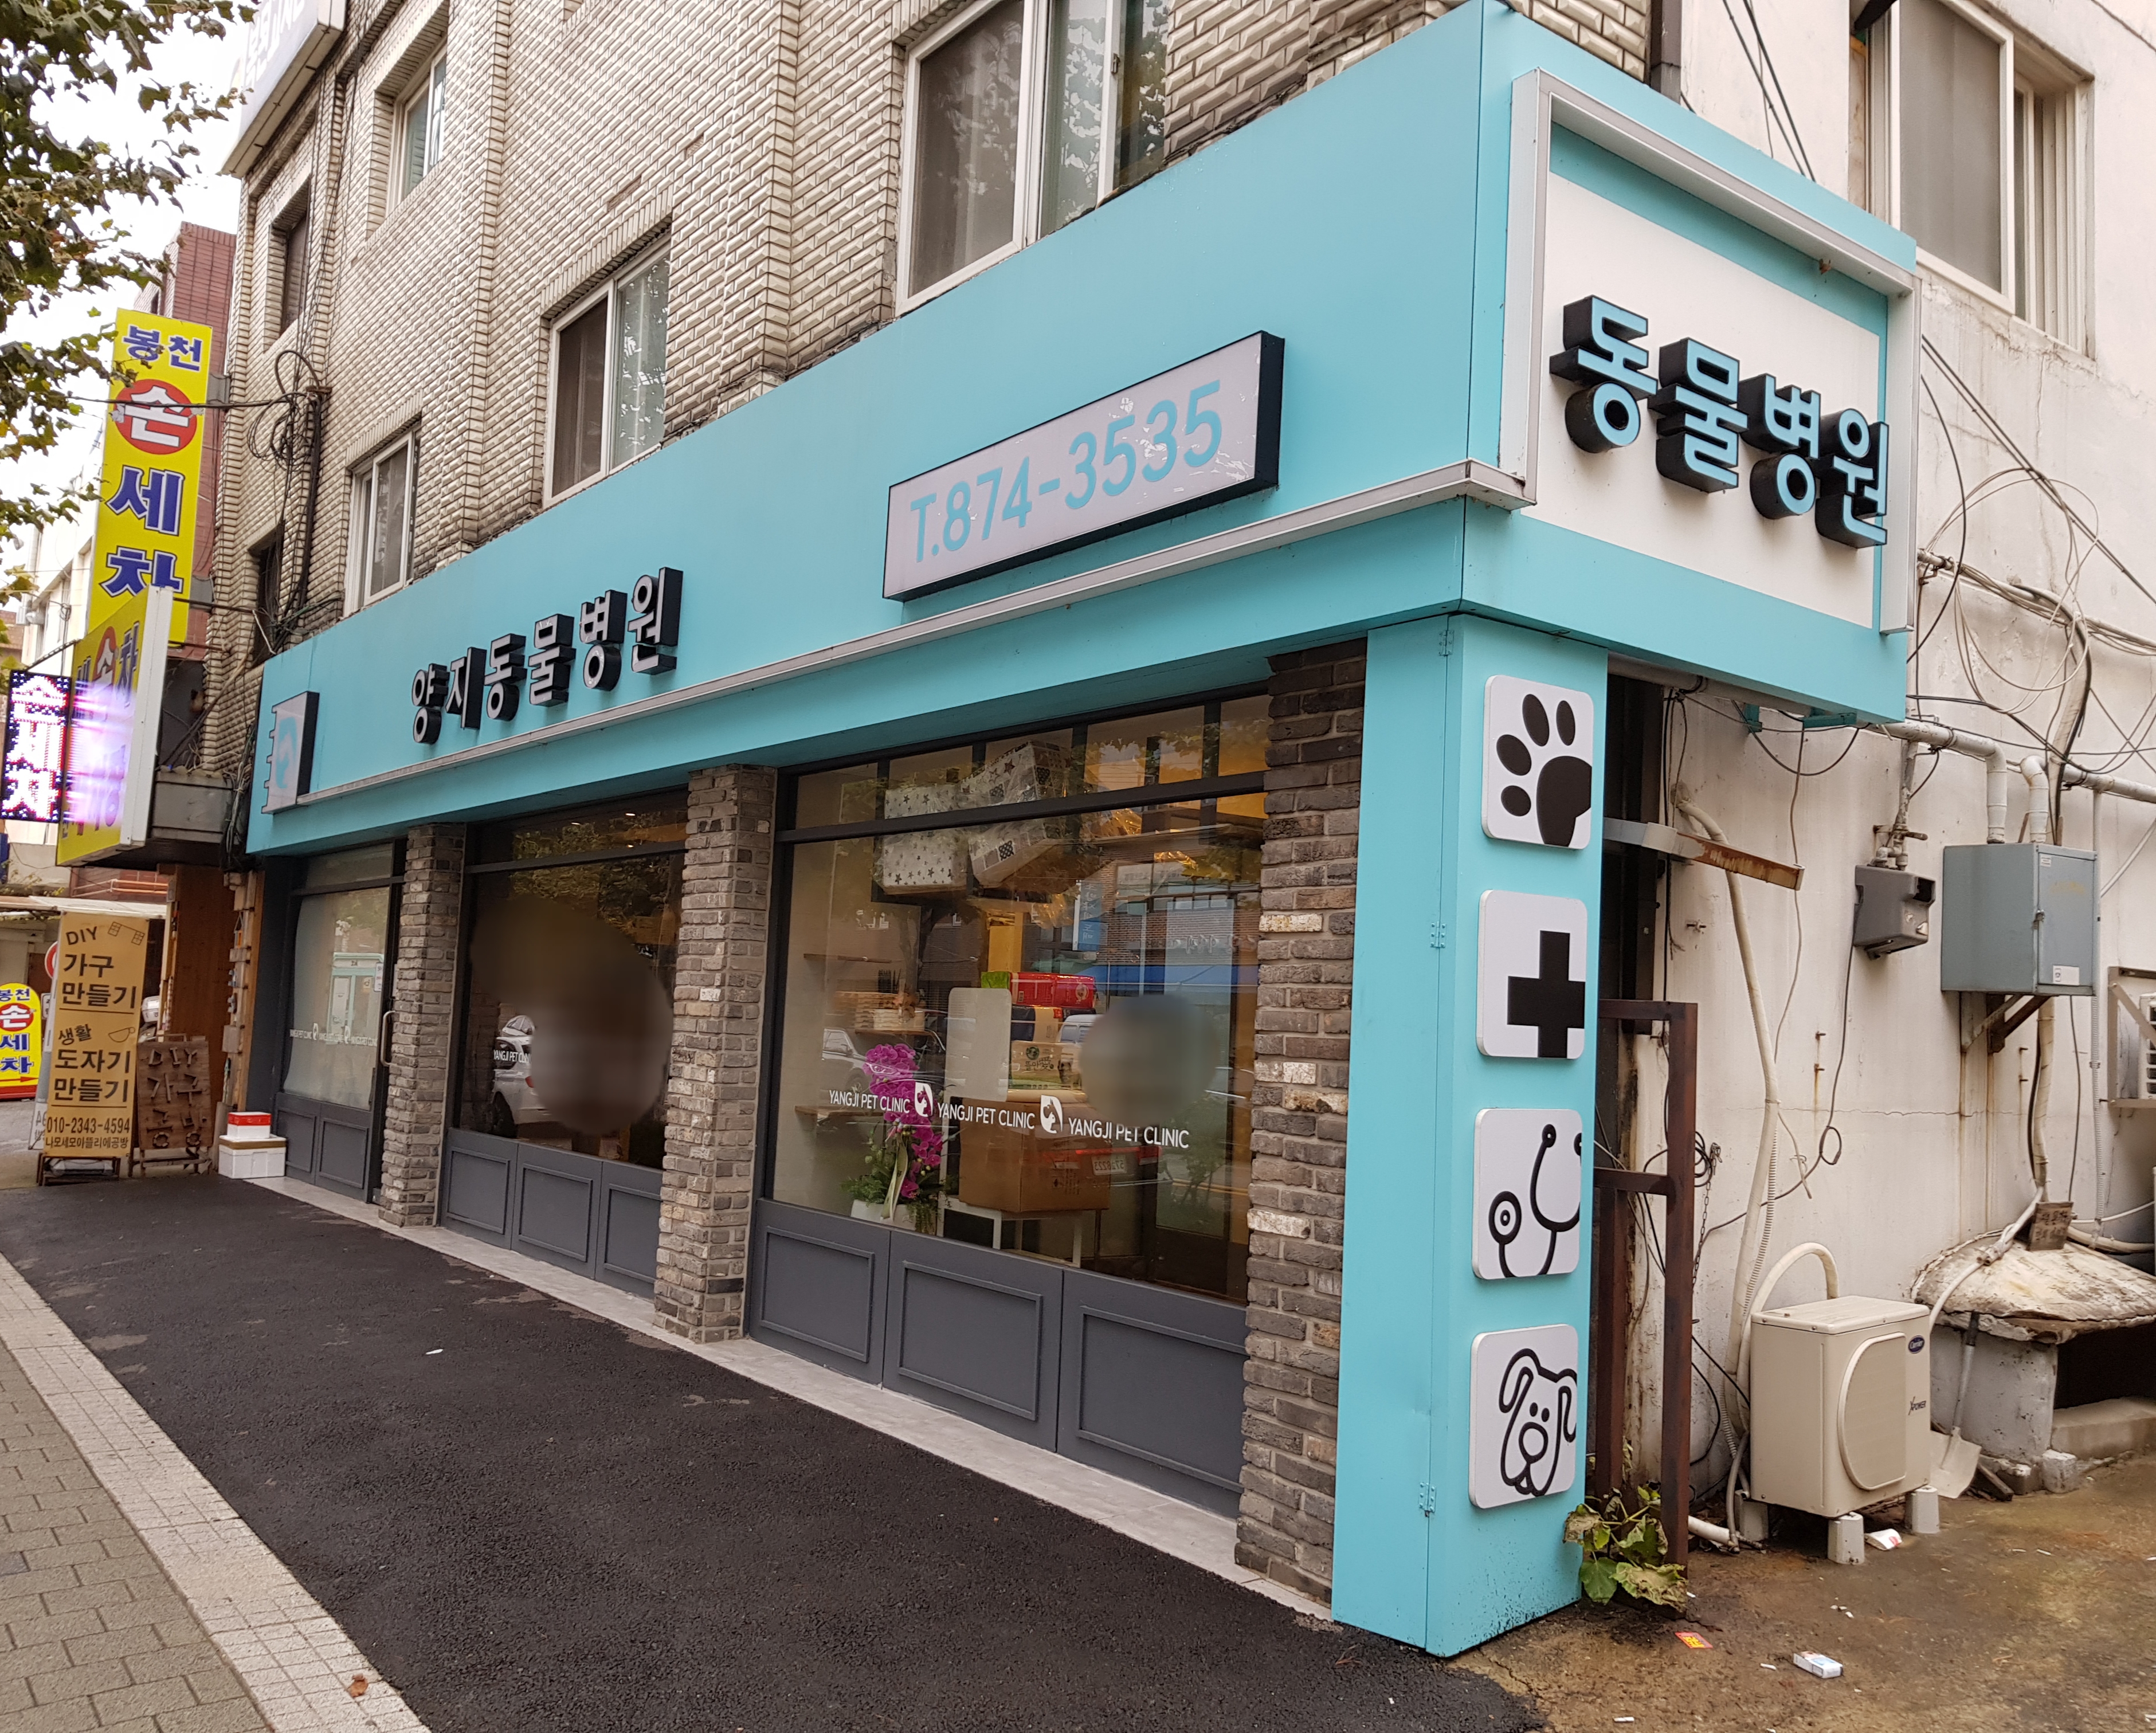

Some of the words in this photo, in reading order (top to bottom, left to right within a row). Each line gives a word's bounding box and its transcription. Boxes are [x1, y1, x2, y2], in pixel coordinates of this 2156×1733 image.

[122, 325, 202, 372] 봉천
[1550, 295, 1889, 548] 동물병원
[910, 379, 1222, 562] T.874-3535
[411, 567, 684, 744] 양지동물병원
[66, 926, 97, 946] DIY
[64, 954, 114, 978] 가구
[0, 989, 30, 1002] 봉천
[62, 982, 136, 1009] 만들기
[58, 1024, 92, 1045] 생활
[55, 1049, 131, 1073] 도자기
[148, 1046, 198, 1067] DIY
[54, 1078, 128, 1103] 만들기
[147, 1073, 205, 1107] 가구
[829, 1090, 859, 1107] YANGJI
[861, 1093, 879, 1109] PET
[880, 1096, 910, 1113] CLINIC
[47, 1117, 130, 1134] 010-2343-4594
[937, 1102, 973, 1122] YANGJI
[976, 1107, 996, 1124] PET
[998, 1109, 1035, 1130] CLINIC
[1068, 1118, 1112, 1139] YANGJI
[1116, 1123, 1140, 1142] PET
[1144, 1126, 1189, 1148] CLINIC
